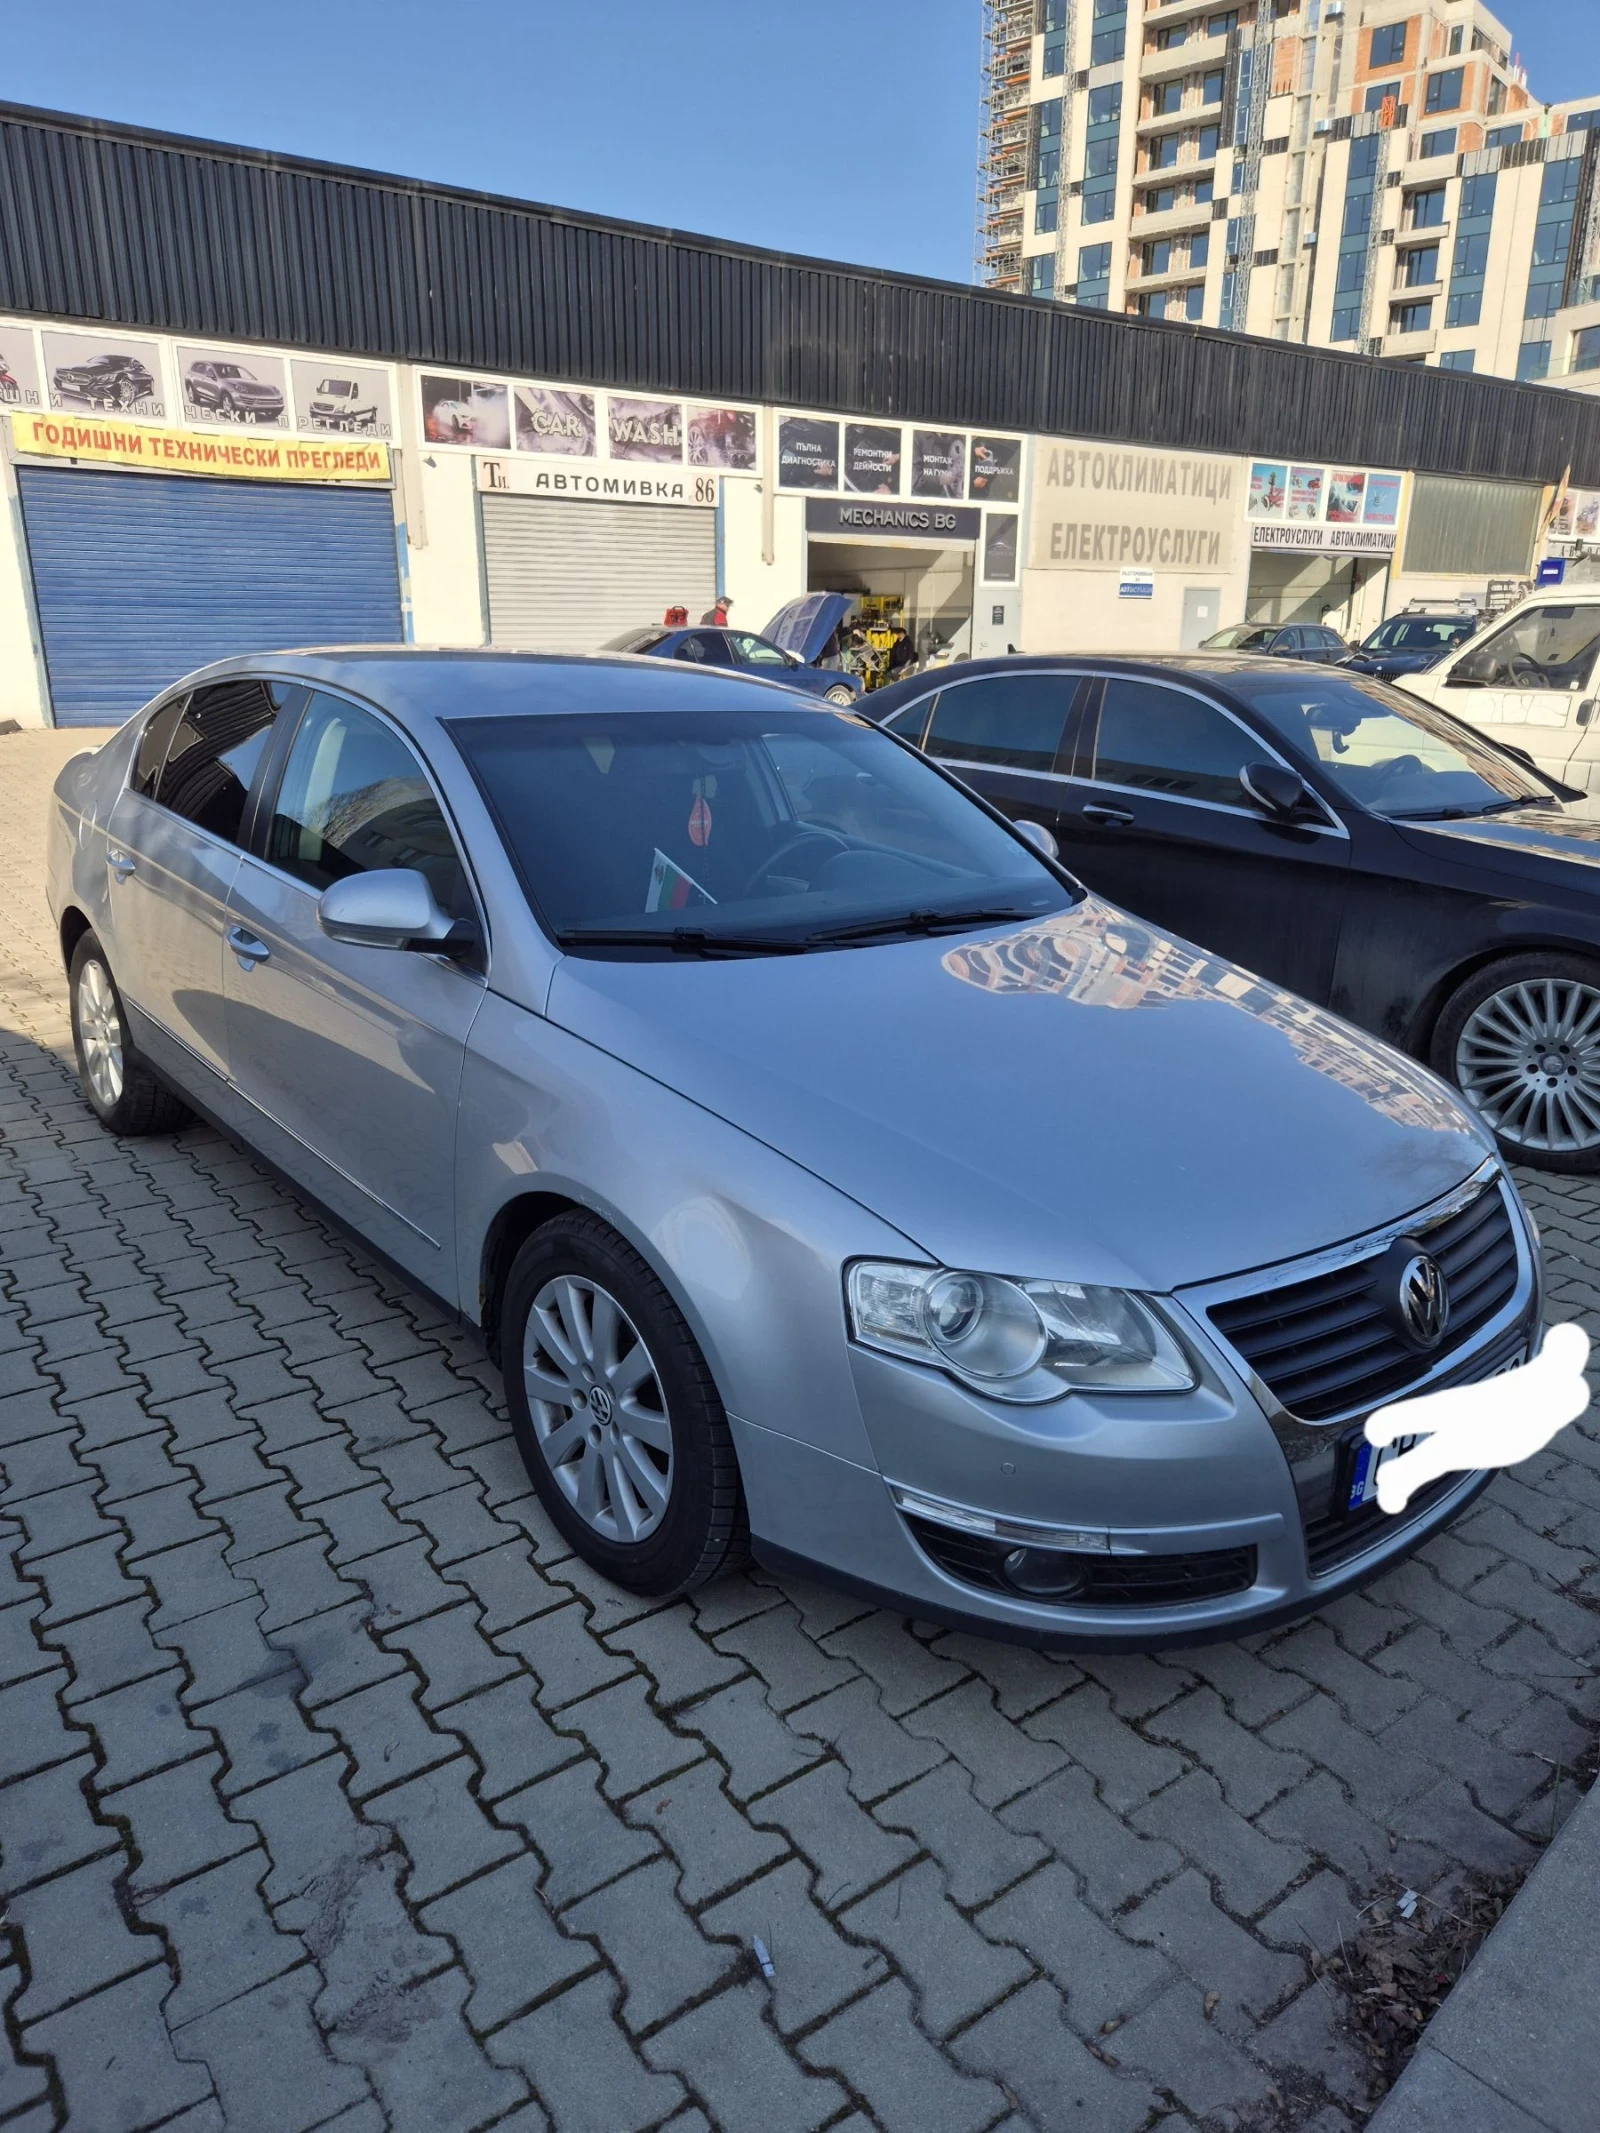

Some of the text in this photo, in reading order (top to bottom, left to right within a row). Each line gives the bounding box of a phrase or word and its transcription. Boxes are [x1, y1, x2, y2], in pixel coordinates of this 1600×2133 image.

[86, 396, 257, 425] ТЕХНИЧЕСКИ
[276, 414, 392, 437] ПРЕГЛЕДИ
[531, 408, 682, 446] CAR WASH
[32, 421, 381, 472] ГОДИШНИ ТЕХНИЧЕСКИ ПРЕГЛЕДИ
[796, 442, 822, 453] ПЪЛНА
[853, 448, 892, 459] РЕМОНТНИ
[781, 455, 836, 468] ДИАГНОСТИКА
[853, 460, 892, 472] ДЕЙНОСТИ
[923, 455, 953, 465] МОНТАЖ
[974, 465, 1014, 475] ПОДДРЪЖКА
[1046, 447, 1232, 505] АВТОКЛИМАТИЦИ
[536, 473, 684, 499] АВТОМИВКА
[694, 477, 715, 503] 86
[839, 507, 956, 530] MECHANICS BG
[1050, 522, 1221, 565] ЕЛЕКТРОУСЛУГИ
[1253, 526, 1397, 549] ЕЛЕКТРОУСЛУГИ АВТОКЛИМАТИЦИ
